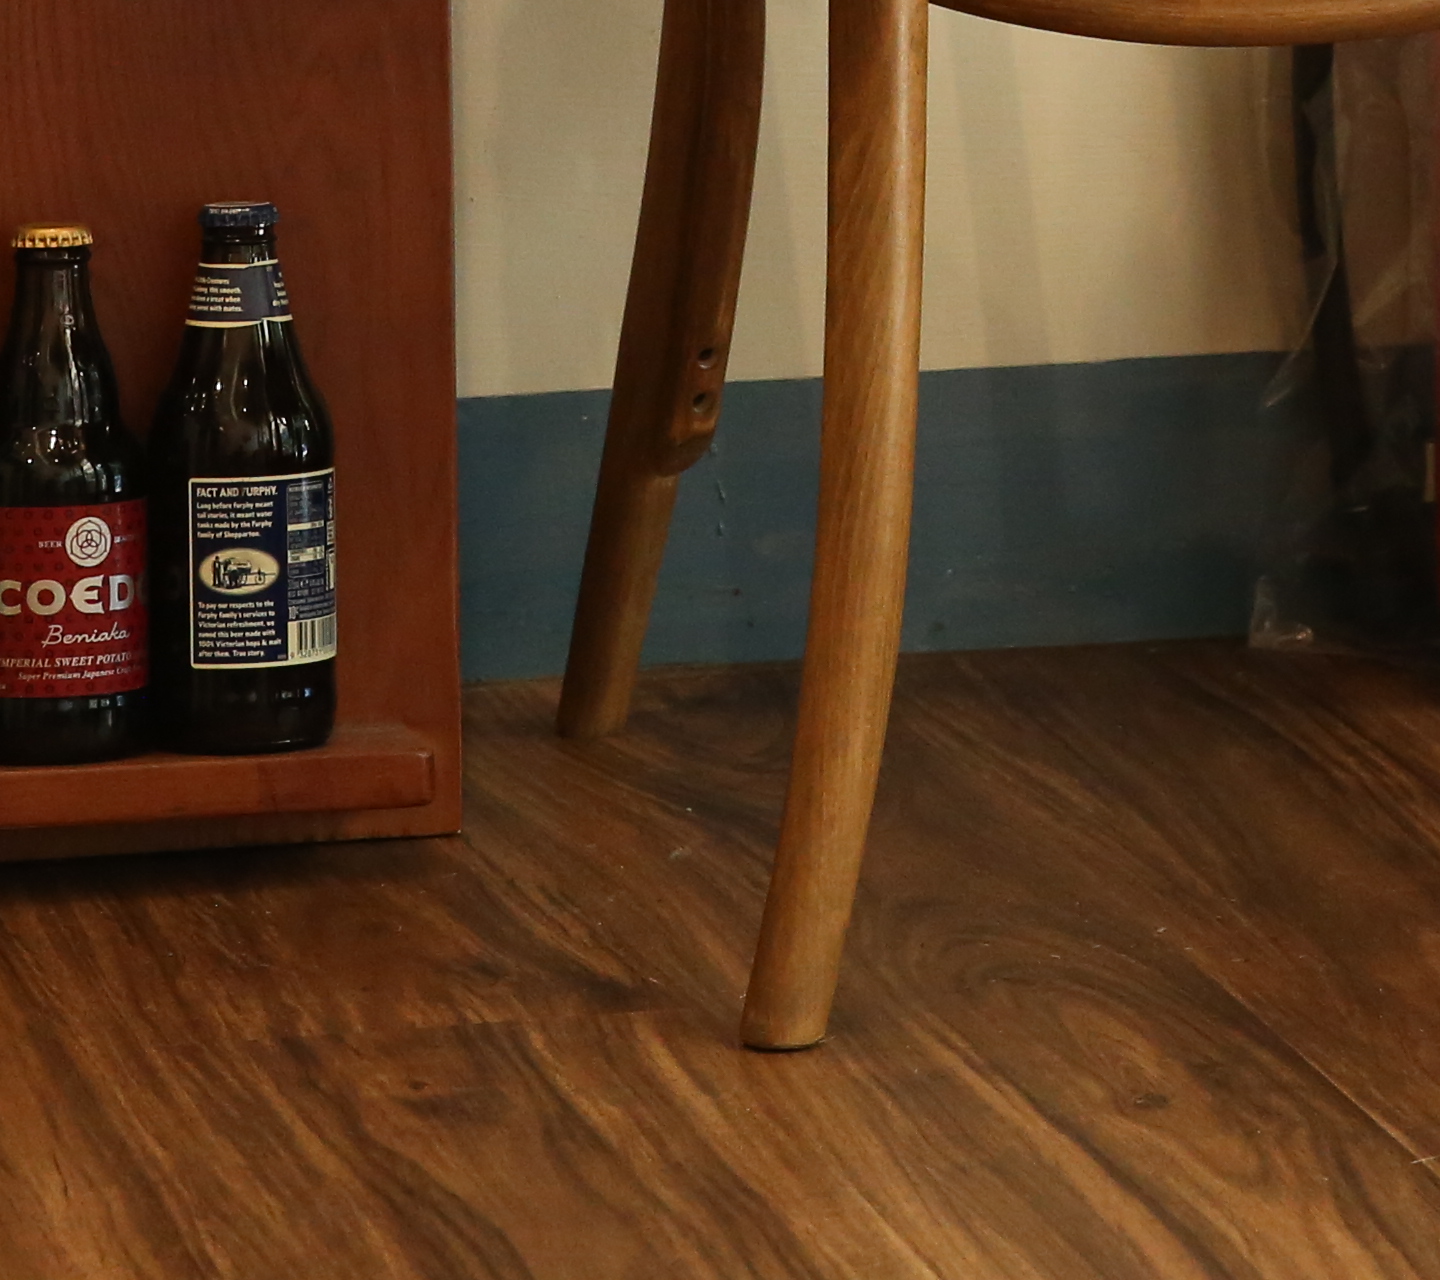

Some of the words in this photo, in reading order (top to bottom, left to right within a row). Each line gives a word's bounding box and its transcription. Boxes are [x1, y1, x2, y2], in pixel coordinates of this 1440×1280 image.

[196, 488, 218, 497] FACT
[220, 487, 238, 497] AND
[38, 541, 62, 549] BEER
[264, 600, 274, 608] the
[41, 621, 131, 648] Beniaka
[262, 629, 276, 637] with
[54, 655, 93, 667] SWEET
[18, 671, 41, 682] Super
[42, 670, 80, 680] Premium
[82, 669, 115, 680] Japanese
